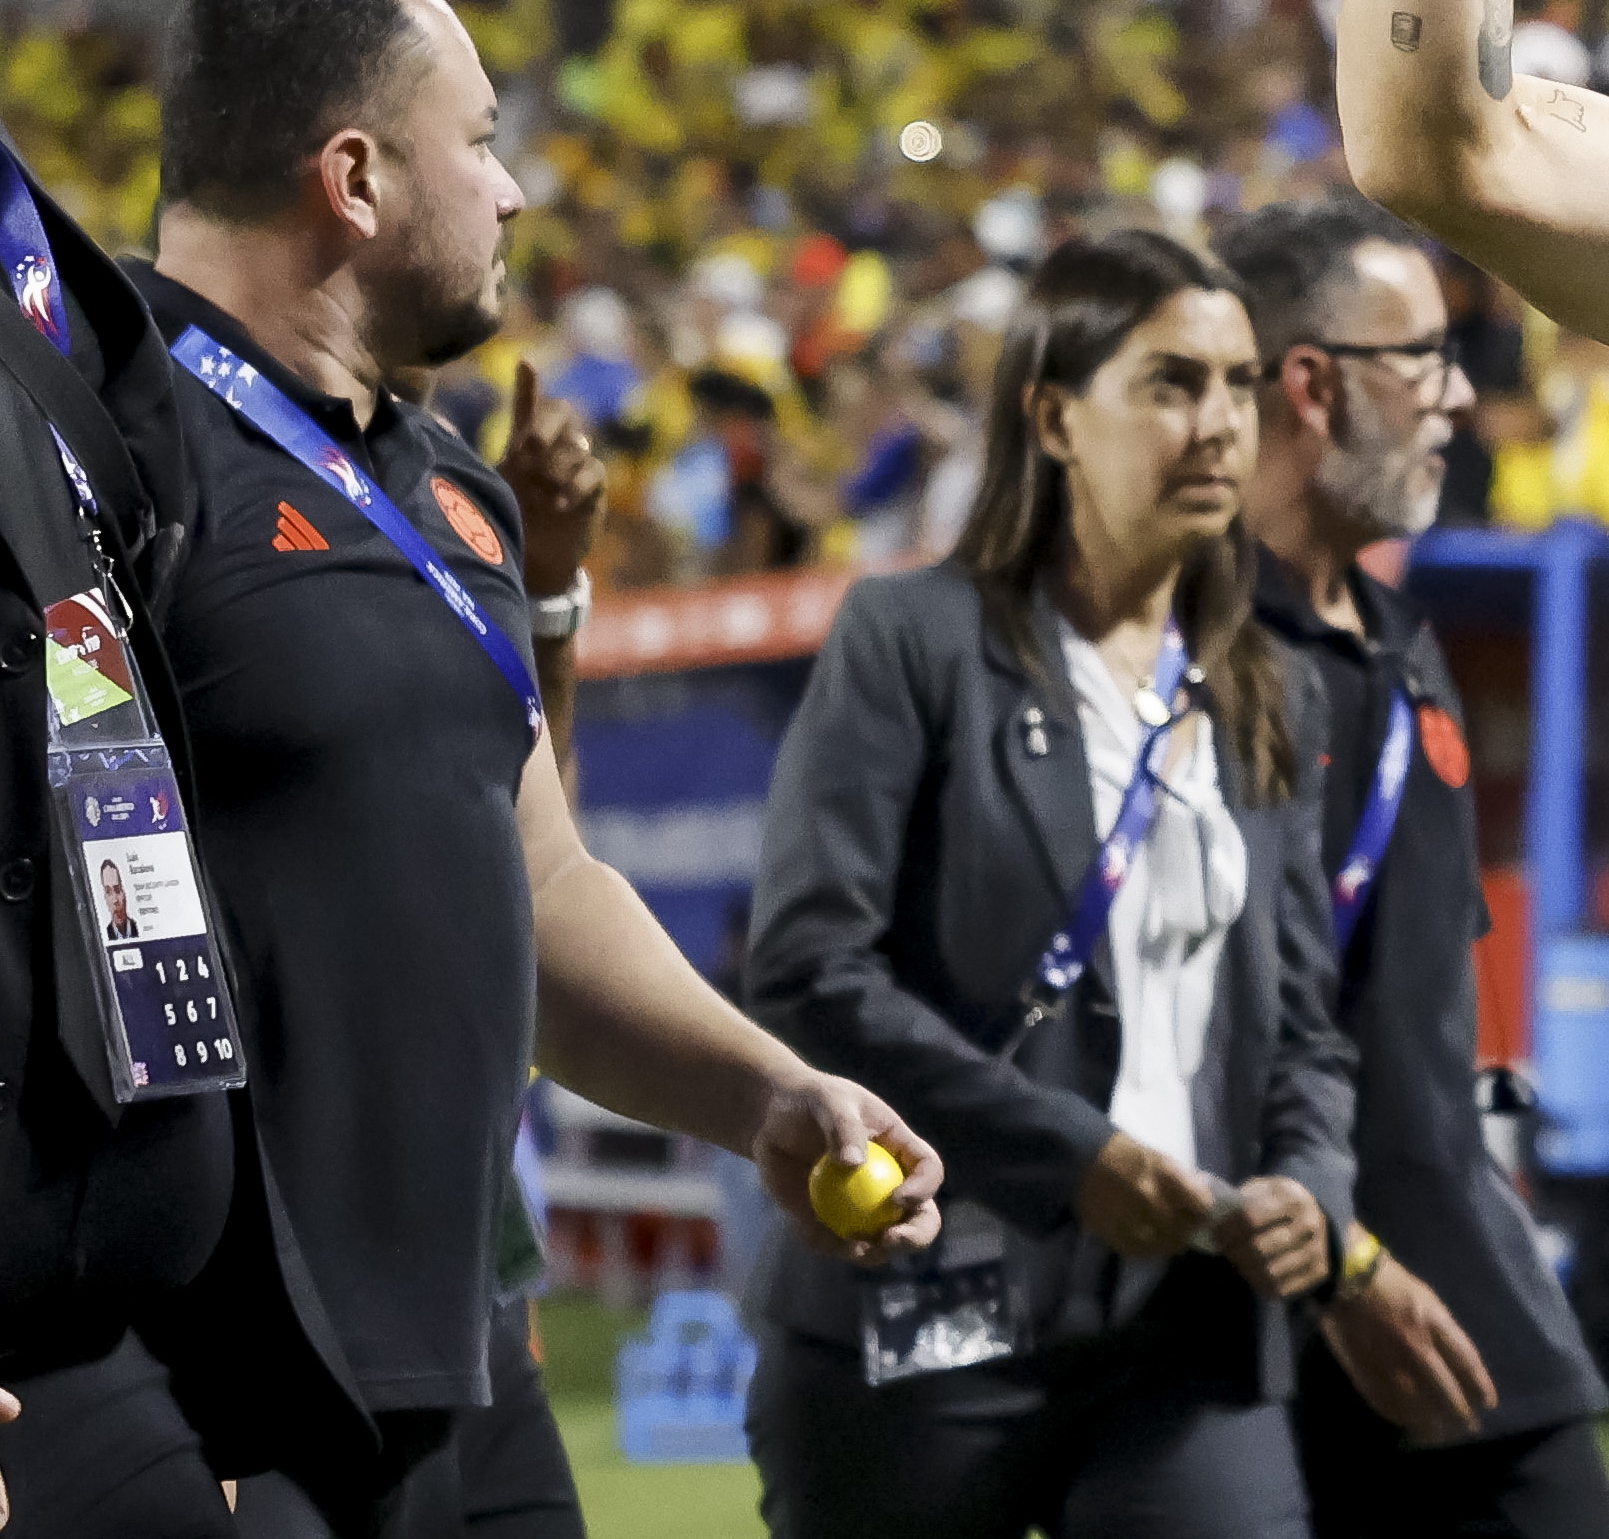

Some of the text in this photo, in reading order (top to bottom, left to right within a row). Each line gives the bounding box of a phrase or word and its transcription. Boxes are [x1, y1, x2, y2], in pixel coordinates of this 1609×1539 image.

[156, 956, 210, 984] 1 2 4
[164, 997, 216, 1026] 5 6 7
[174, 1038, 233, 1066] 8 9 10
